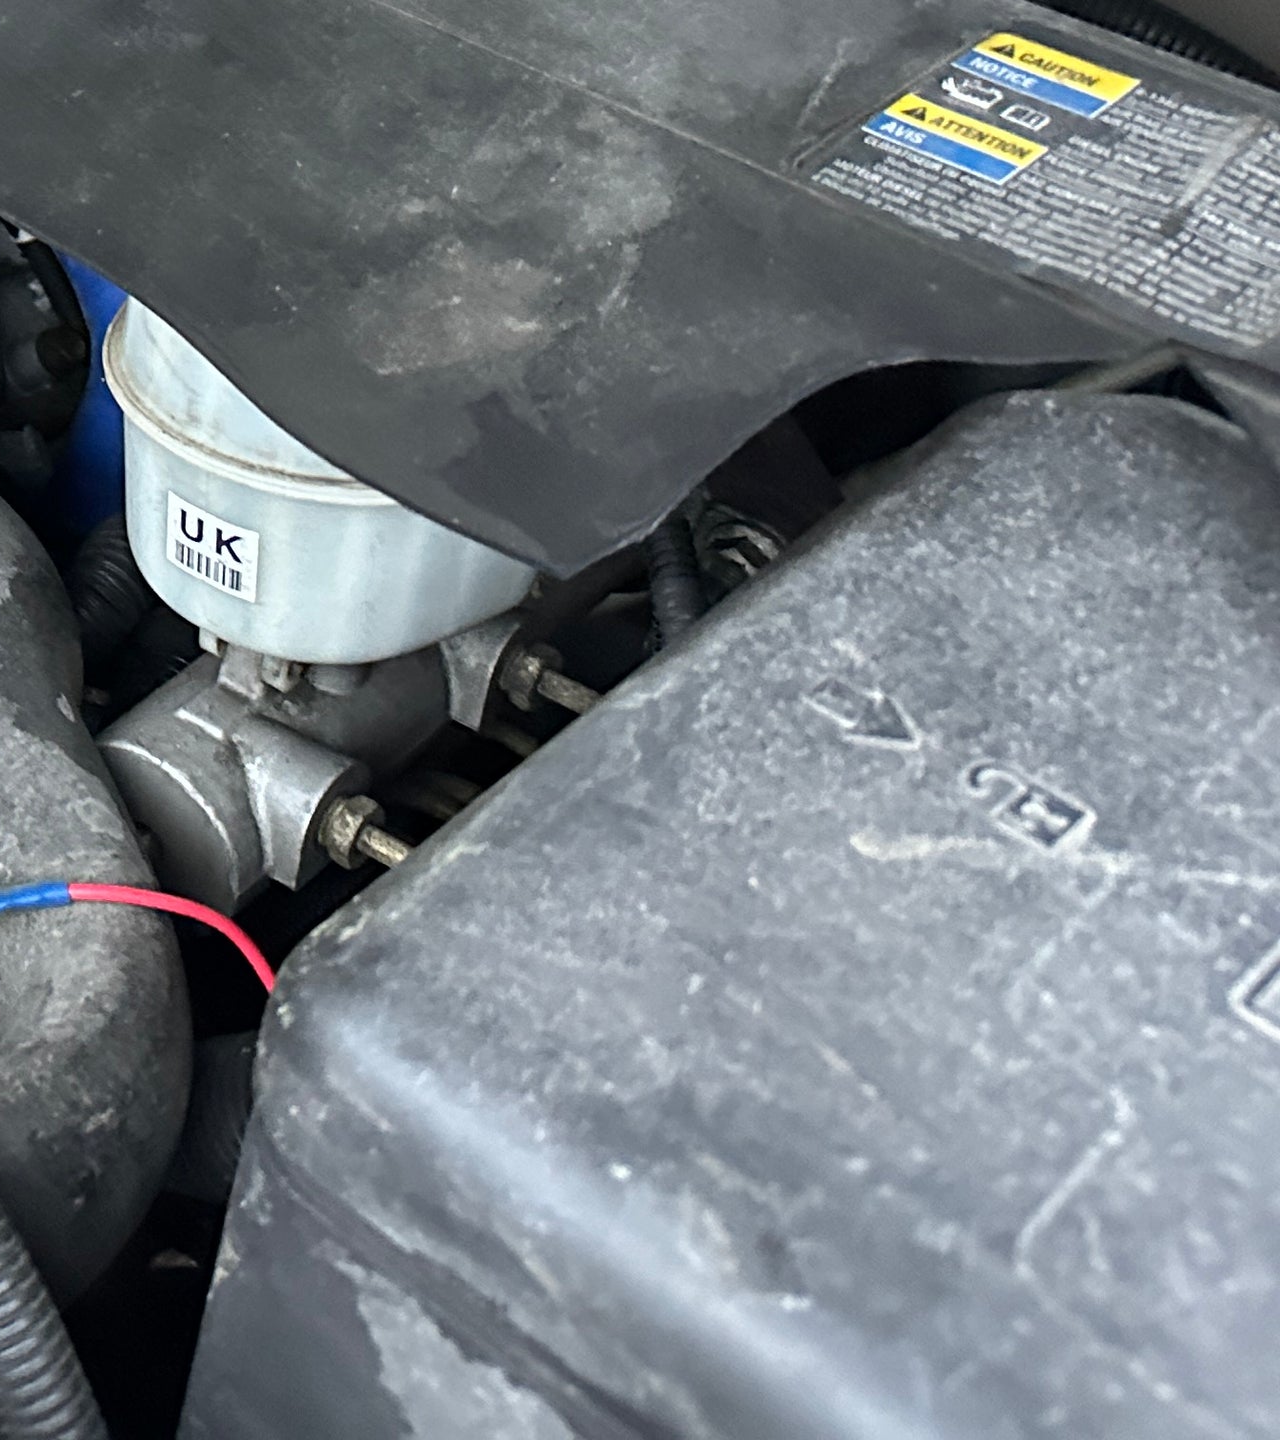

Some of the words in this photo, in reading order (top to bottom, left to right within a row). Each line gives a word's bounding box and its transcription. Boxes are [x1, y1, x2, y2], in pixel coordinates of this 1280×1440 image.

[968, 55, 1038, 90] NOTICE
[1018, 50, 1100, 88] CAUTION
[879, 120, 927, 144] AVIS
[928, 114, 1033, 160] ATTENTION
